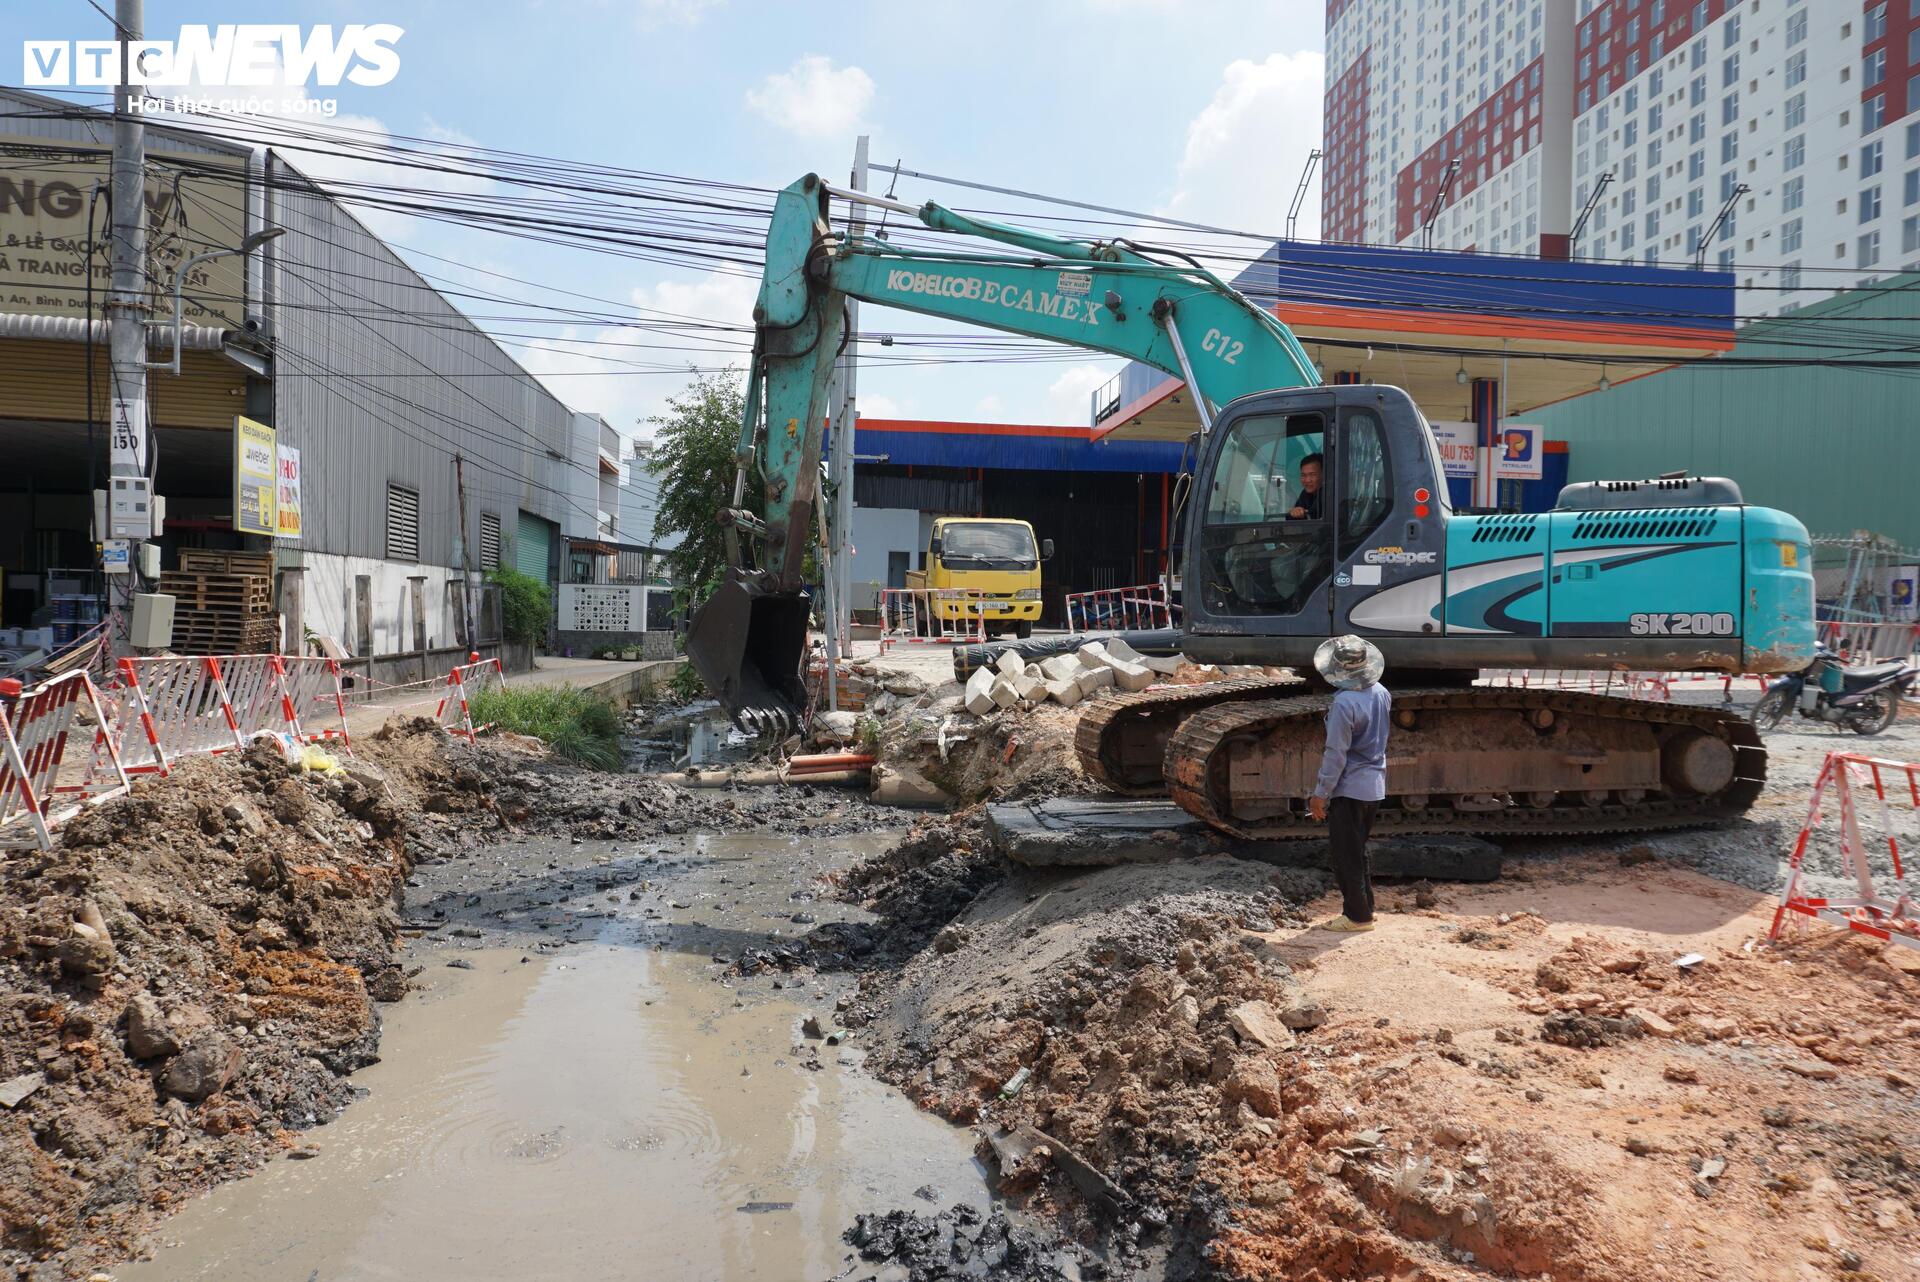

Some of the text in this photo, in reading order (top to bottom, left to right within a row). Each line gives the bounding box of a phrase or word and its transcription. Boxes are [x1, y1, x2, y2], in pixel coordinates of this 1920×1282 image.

[7, 234, 19, 246] &
[26, 232, 43, 249] LẺ
[17, 258, 84, 276] TRANG
[92, 264, 113, 279] TR
[36, 296, 62, 307] Bình
[68, 298, 106, 312] Dưng
[887, 269, 1103, 325] KOBELCO BECAMEX
[1201, 328, 1245, 365] C12
[113, 435, 138, 449] 150
[1458, 445, 1475, 460] 753
[1630, 613, 1733, 635] SK200
